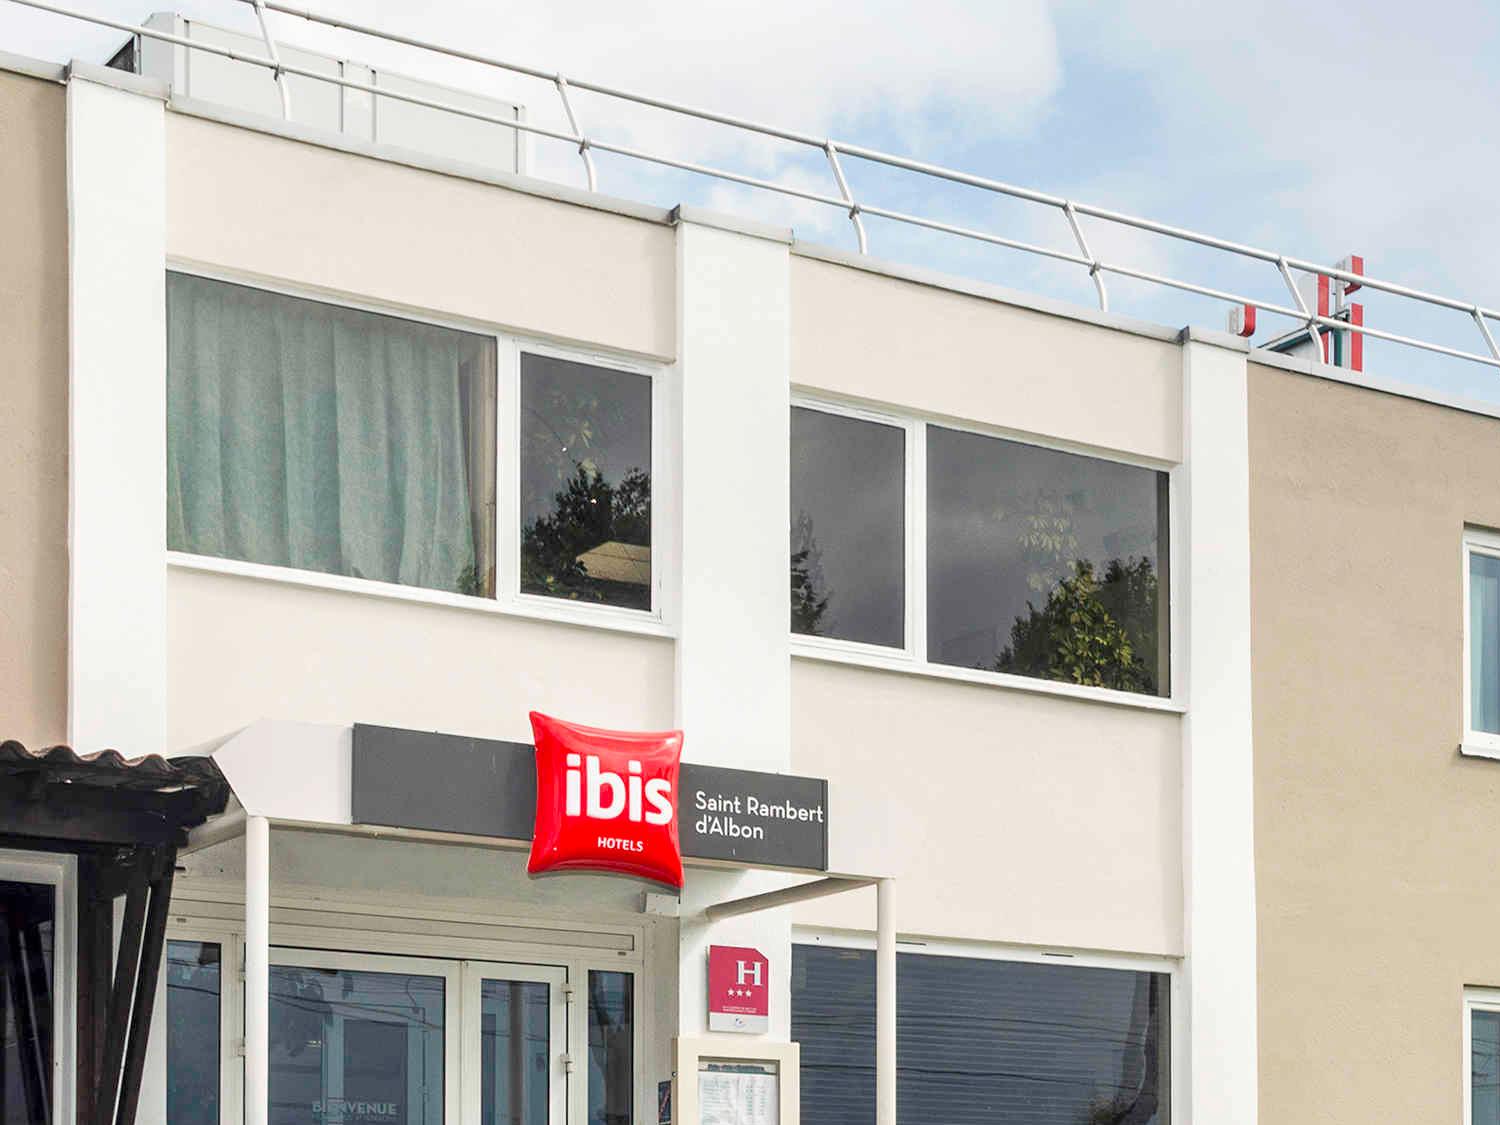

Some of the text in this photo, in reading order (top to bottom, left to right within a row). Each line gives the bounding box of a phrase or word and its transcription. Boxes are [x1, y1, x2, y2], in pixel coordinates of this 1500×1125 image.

[565, 752, 674, 825] ibis
[695, 790, 824, 824] Saint Rambert
[695, 818, 764, 841] d'Albon
[597, 835, 644, 853] HOTELS
[736, 960, 764, 986] H
[312, 1102, 397, 1114] BIENVENUE
